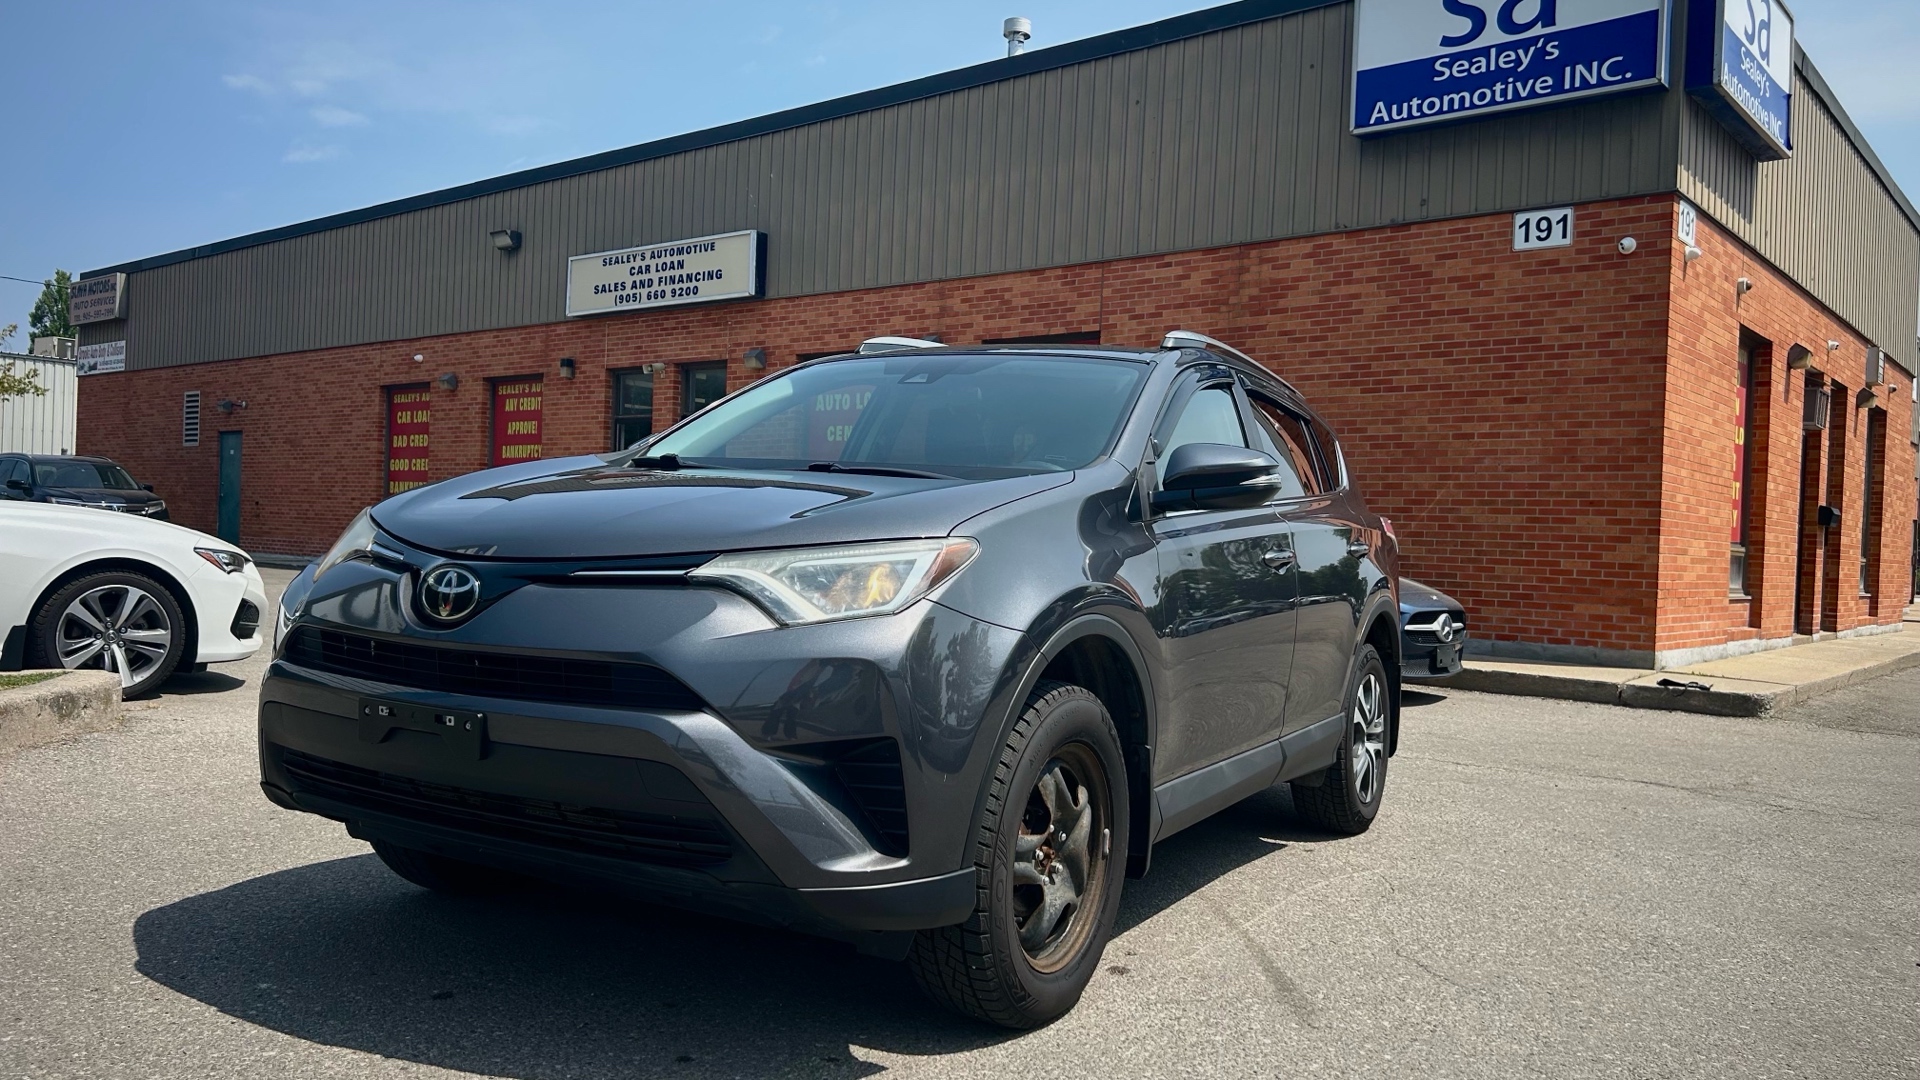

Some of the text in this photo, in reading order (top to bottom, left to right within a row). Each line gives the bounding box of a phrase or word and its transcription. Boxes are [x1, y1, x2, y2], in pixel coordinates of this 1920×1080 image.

[1433, 38, 1560, 81] Sealey's
[1741, 46, 1770, 98] Sealey's
[1369, 56, 1633, 124] Automotive INC.
[1723, 62, 1769, 129] Automotive
[1518, 214, 1569, 243] 191
[1681, 208, 1694, 240] 191
[602, 242, 716, 267] SEALEY'S AUTOMOTIVE
[629, 259, 685, 276] CAR LOAN
[593, 269, 723, 295] SALES AND FINANCING
[73, 296, 116, 311] AUTO SERVICES
[614, 285, 699, 306] (905) 660 9200
[394, 393, 420, 403] SEALEY'S
[498, 383, 529, 395] SEALEY'S
[505, 396, 542, 412] ANY CREDIT
[816, 393, 850, 411] AUTO
[397, 411, 411, 424] CAR
[393, 434, 429, 448] BAD CRED
[502, 444, 543, 459] BANKRUPTCY
[390, 459, 410, 471] GOOD
